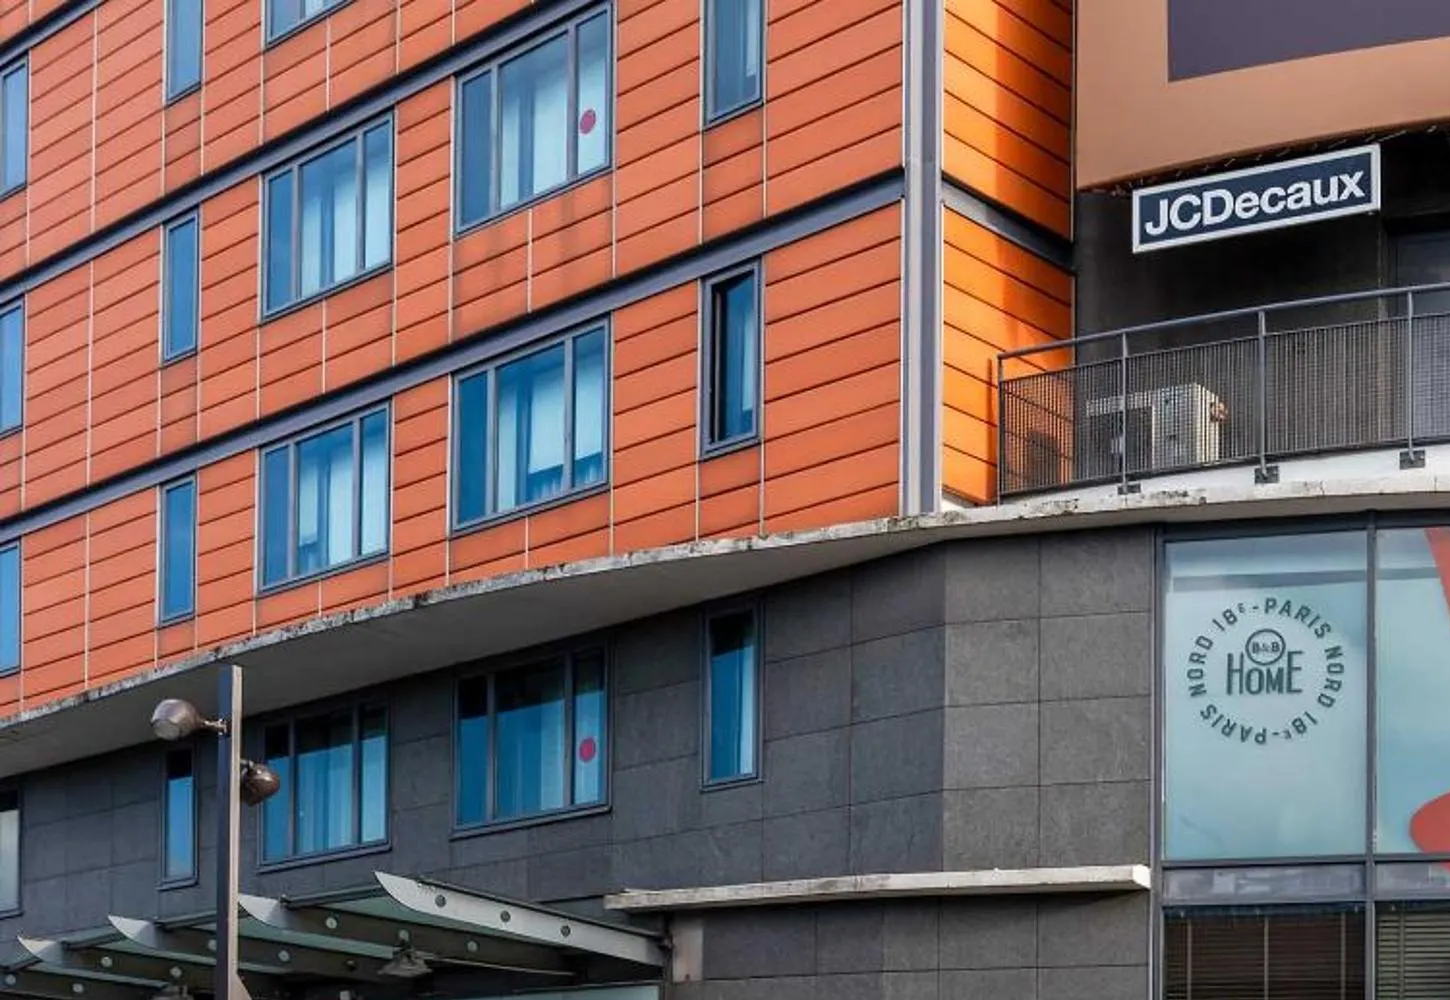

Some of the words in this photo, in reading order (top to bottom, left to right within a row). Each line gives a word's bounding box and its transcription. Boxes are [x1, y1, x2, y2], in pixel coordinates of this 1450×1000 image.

[1145, 170, 1366, 236] JCDecaux
[1264, 597, 1332, 639] PARIS
[1186, 635, 1214, 698] NORD
[1226, 650, 1303, 695] HOME
[1317, 645, 1345, 708] NORD
[1200, 704, 1267, 745] PARIS
